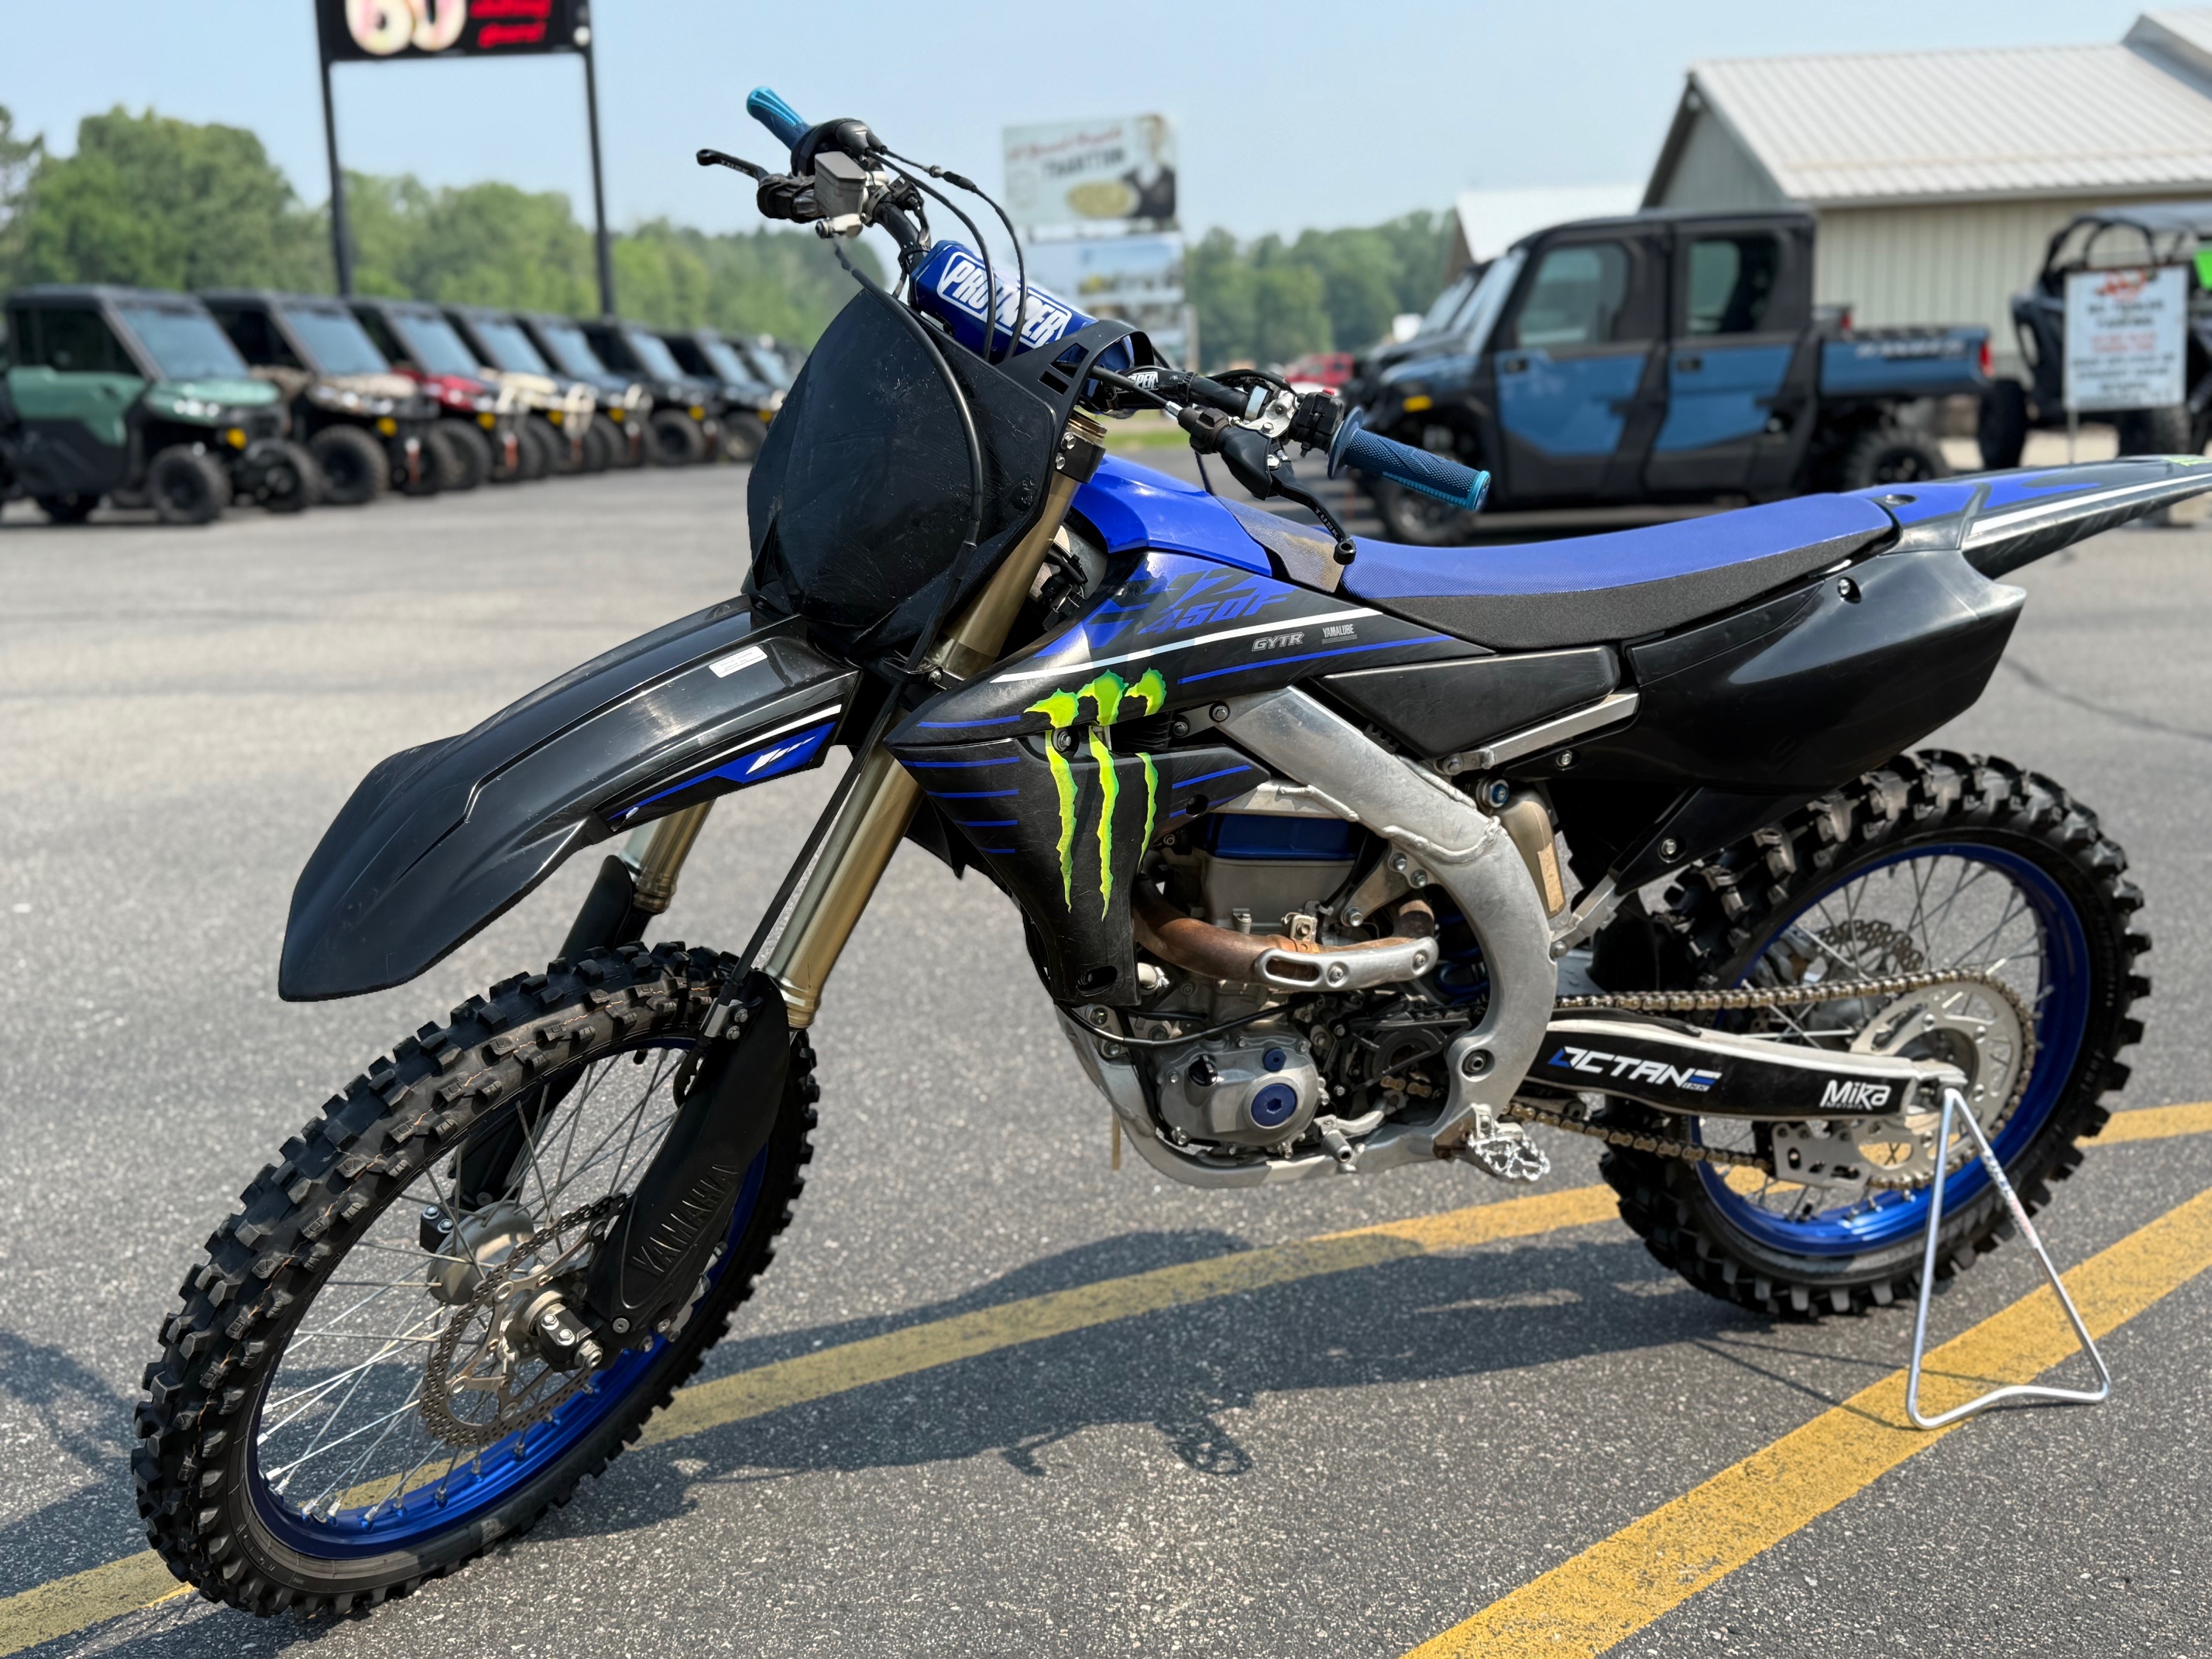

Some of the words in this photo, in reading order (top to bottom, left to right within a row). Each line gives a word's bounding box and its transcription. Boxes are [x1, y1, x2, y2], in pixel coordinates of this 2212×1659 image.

[1315, 507, 1339, 538] TUSK
[1252, 632, 1304, 651] GYTR
[1322, 624, 1355, 638] YAMALUBE
[1547, 1046, 1723, 1091] OCTANE
[1819, 1080, 1891, 1110] Mika
[632, 1164, 739, 1276] YAMAHA
